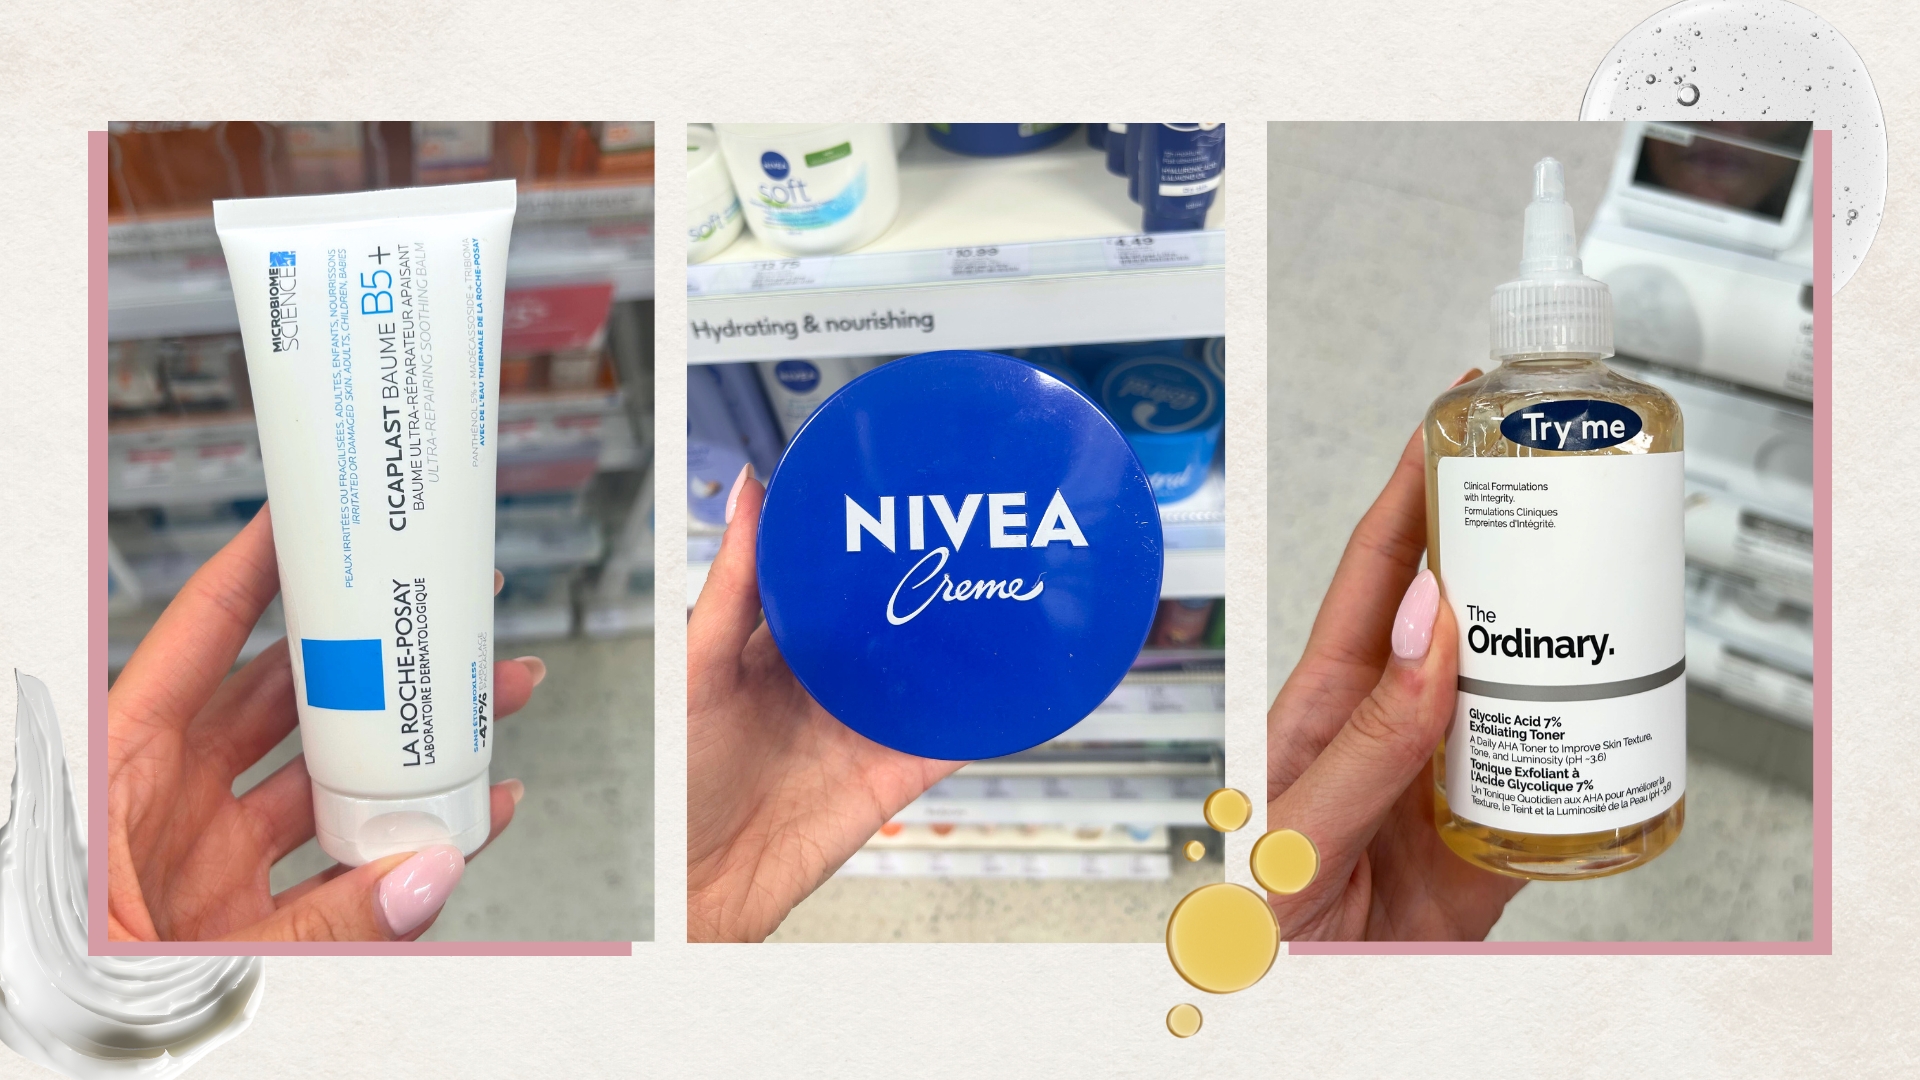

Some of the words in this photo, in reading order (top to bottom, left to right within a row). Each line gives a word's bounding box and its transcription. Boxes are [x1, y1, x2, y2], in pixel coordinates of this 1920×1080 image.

[759, 178, 811, 205] soft
[338, 248, 348, 280] BABIES
[397, 244, 413, 308] APAISANT
[414, 241, 428, 276] BALM
[462, 237, 472, 283] TRIBIOMA
[472, 237, 483, 301] ROCHE-POSAY
[327, 248, 338, 318] NOURRISSONS
[269, 267, 282, 353] MICROBIOME
[279, 267, 299, 351] SCIENCE
[339, 280, 350, 332] CHILDREN,
[416, 279, 433, 352] SOOTHING
[476, 302, 483, 314] LA
[476, 315, 483, 328] DE
[691, 315, 799, 343] Hydrating
[803, 312, 820, 333] &
[825, 310, 935, 333] nourishing
[330, 318, 341, 369] ENFANTS,
[341, 332, 352, 374] ADULTS,
[466, 292, 477, 379] MADÉCASSOSIDE
[378, 322, 400, 399] BAUME
[332, 370, 344, 418] ADULTES,
[402, 310, 422, 458] ULTRA-RÉPARATEUR
[470, 389, 478, 404] 5%
[345, 404, 357, 455] DAMAGED
[421, 354, 440, 484] ULTRA-REPAIRING
[479, 409, 485, 422] DE
[1522, 412, 1572, 449] Try
[1581, 419, 1626, 439] me
[470, 406, 479, 468] PANTHÉNOL
[348, 454, 358, 471] OR
[383, 405, 407, 532] CICAPLAST
[340, 488, 349, 505] OU
[350, 471, 360, 525] IRRITATED
[410, 460, 425, 511] BAUME
[1463, 481, 1490, 491] Clinical
[1491, 482, 1549, 491] Formulations
[1464, 493, 1480, 502] with
[1480, 493, 1516, 505] Integrity.
[340, 505, 352, 552] IRRITÉES
[845, 488, 1089, 554] NIVEA
[1464, 506, 1515, 516] Formulations
[1516, 507, 1558, 519] Cliniques
[1464, 517, 1508, 529] Empreintes
[1509, 519, 1556, 531] d'Intégrité.
[344, 553, 353, 588] PEAUX
[886, 546, 1045, 626] Creme
[415, 577, 432, 684] DERMATOLOGIQUE
[1466, 604, 1497, 624] The
[392, 578, 419, 735] ROCHE-POSAY
[1467, 624, 1615, 666] Ordinary.
[420, 686, 436, 765] LABORATOIRE
[478, 692, 487, 748] -47%
[1469, 707, 1512, 725] Glycolic
[1513, 714, 1541, 727] Acid
[1543, 716, 1563, 729] 7%
[1469, 720, 1528, 742] Exfoliating
[1529, 729, 1566, 741] Toner
[402, 738, 421, 767] LA
[1469, 734, 1476, 743] A
[1476, 736, 1497, 751] Daily
[1497, 740, 1519, 752] AHA
[1519, 742, 1548, 753] Toner
[1549, 744, 1560, 753] to
[1561, 743, 1601, 755] Improve
[1602, 739, 1622, 750] Skin
[1623, 732, 1653, 747] Texture,
[1469, 745, 1491, 759] Tone,
[1492, 752, 1509, 761] and
[1511, 753, 1564, 767] Luminosity
[1565, 754, 1583, 767] (pH
[1585, 752, 1607, 764] ~3.6)
[1470, 757, 1513, 776] Tonique
[1514, 766, 1569, 779] Exfoliant
[1571, 767, 1580, 779] à
[1470, 769, 1505, 787] l'Acide
[1507, 778, 1574, 795] Glycolique
[1575, 779, 1594, 793] 7%
[1471, 783, 1482, 795] Un
[1482, 787, 1516, 802] Tonique
[1517, 793, 1562, 805] Quotidien
[1563, 796, 1582, 804] aux
[1582, 793, 1604, 804] AHA
[1605, 790, 1625, 802] pour
[1625, 781, 1660, 797] Améliorer
[1659, 775, 1665, 785] la
[1471, 794, 1501, 811] Texture,
[1502, 802, 1511, 812] le
[1511, 803, 1534, 816] Teint
[1534, 806, 1544, 816] et
[1546, 806, 1555, 816] la
[1556, 803, 1607, 816] Luminosité
[1607, 801, 1620, 812] de
[1620, 800, 1629, 809] la
[1629, 794, 1648, 807] Peau
[1648, 787, 1660, 802] (pH
